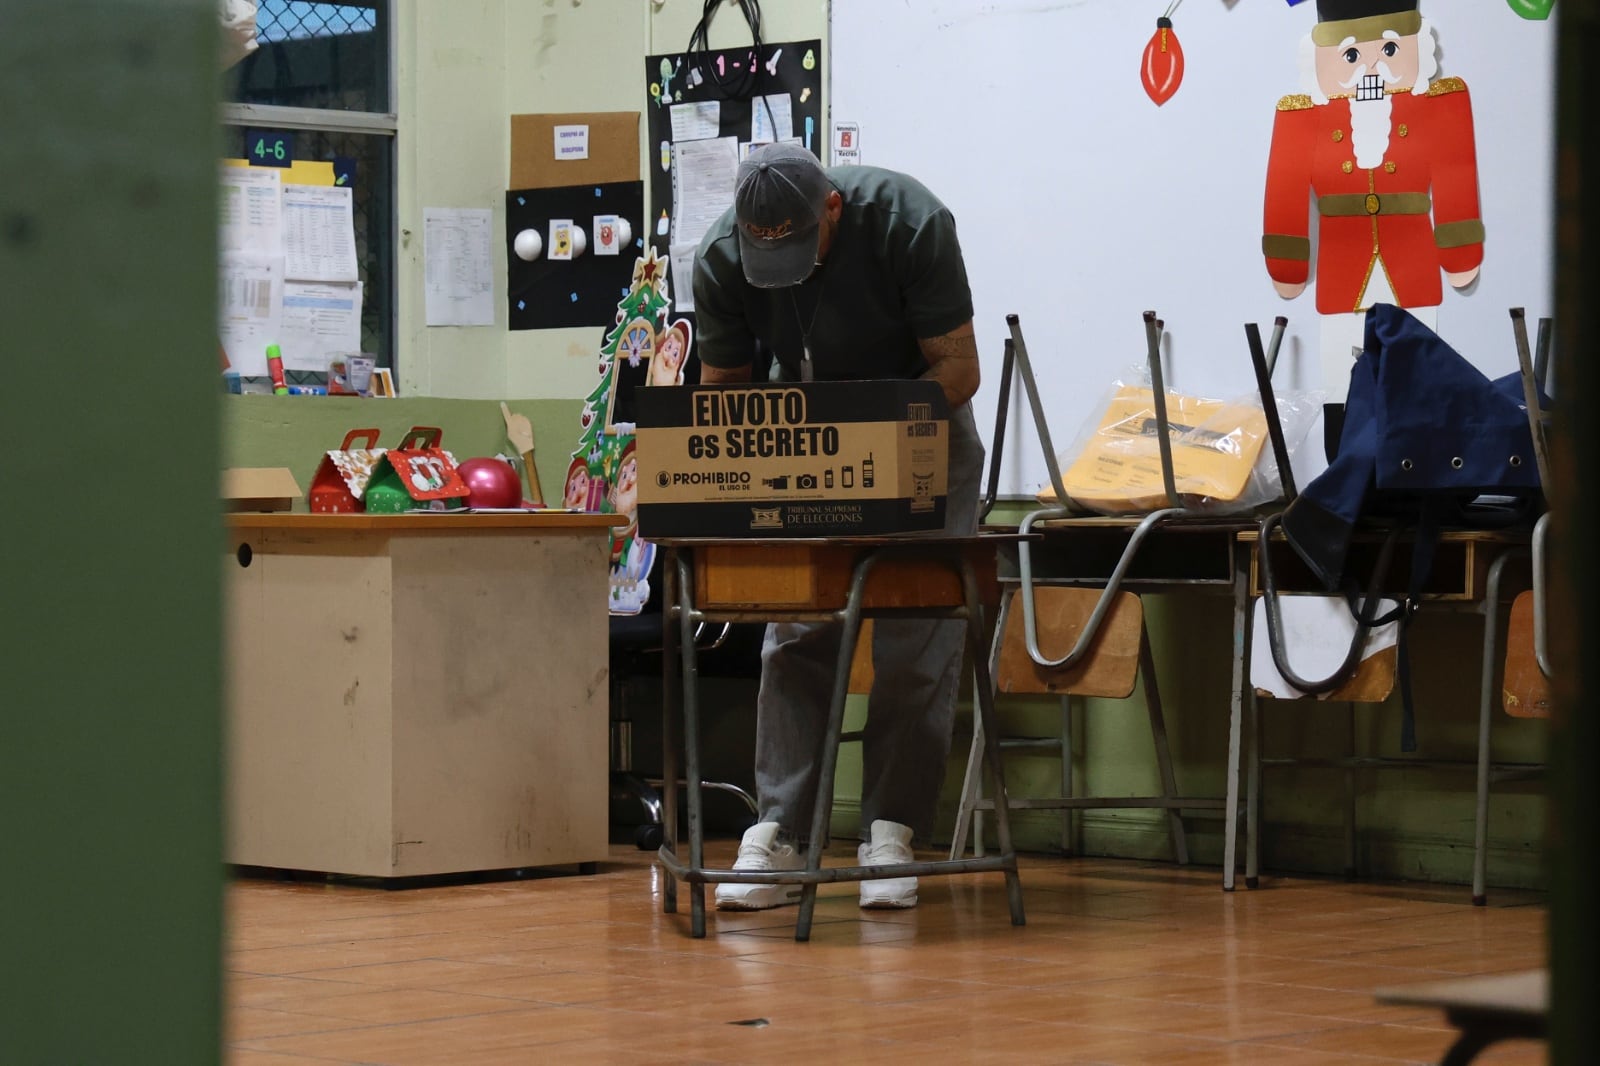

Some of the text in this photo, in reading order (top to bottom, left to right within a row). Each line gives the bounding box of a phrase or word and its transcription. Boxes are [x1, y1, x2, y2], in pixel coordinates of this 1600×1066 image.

[254, 138, 286, 160] 4-6
[724, 391, 804, 426] VOTO
[688, 425, 839, 459] es SECRETO
[673, 471, 751, 485] PROHIBIDO
[787, 504, 862, 514] TRIBUNAL SUPREMO
[787, 513, 863, 524] DE ELECCIONES
